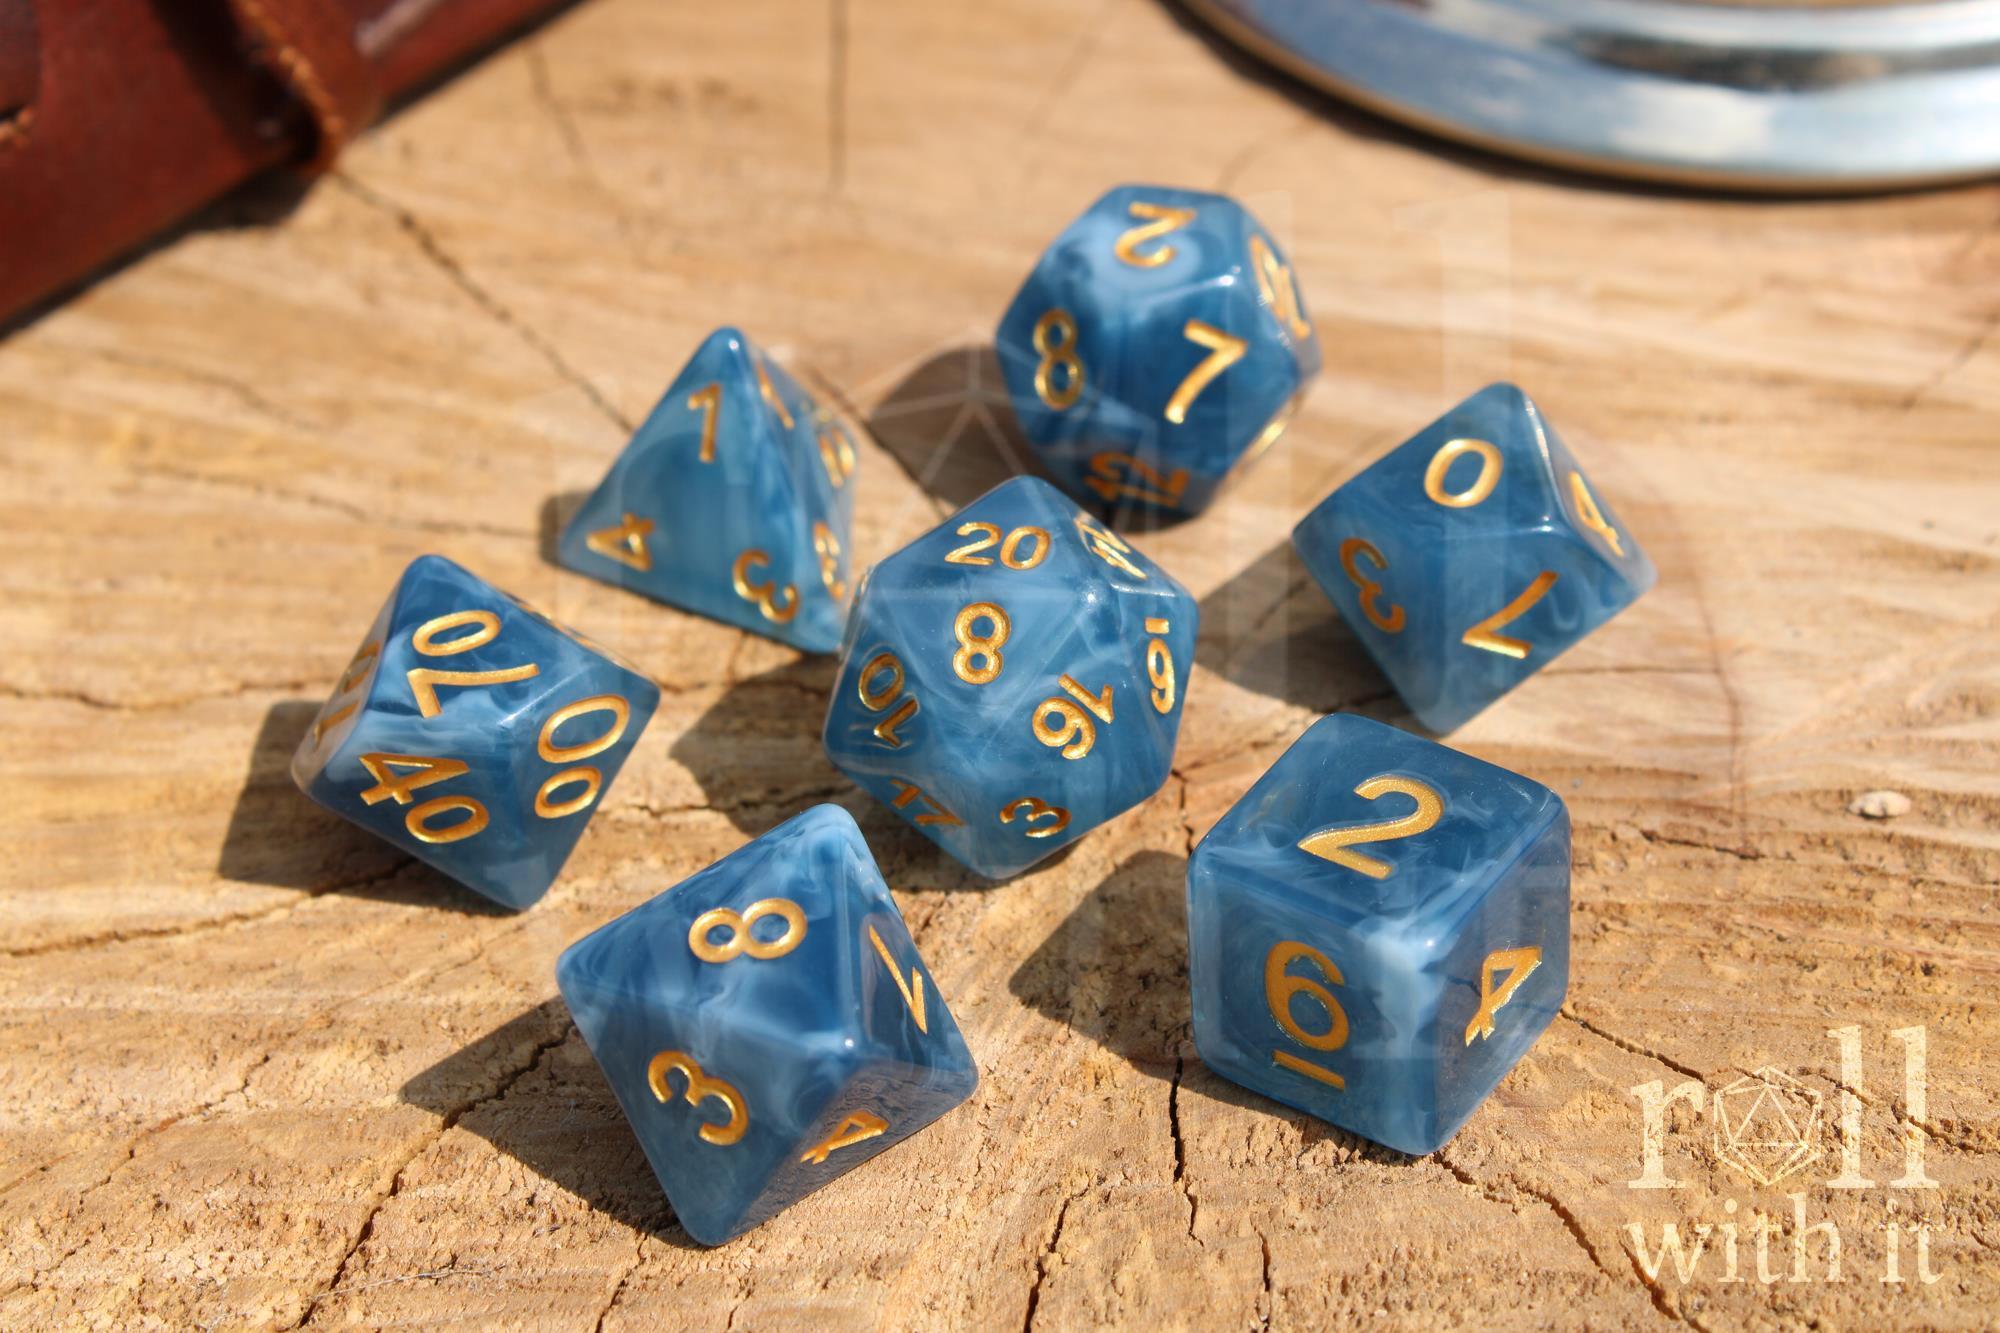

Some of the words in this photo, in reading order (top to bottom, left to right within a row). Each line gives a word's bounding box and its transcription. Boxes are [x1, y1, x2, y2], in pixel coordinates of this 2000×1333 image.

[1115, 201, 1196, 268] 2
[1033, 307, 1084, 411] 8
[1165, 319, 1247, 424] 7
[687, 382, 722, 464] 1
[1424, 438, 1503, 508] 0
[1569, 471, 1624, 557] 4
[586, 512, 655, 572] 4
[732, 547, 797, 623] 3
[944, 522, 1051, 570] 20
[1339, 537, 1406, 634] 3
[953, 602, 1011, 684] 8
[1461, 570, 1559, 659] 7
[407, 610, 540, 720] 70
[858, 652, 918, 747] 10
[1032, 673, 1113, 760] 16
[359, 752, 490, 843] 40
[1000, 798, 1071, 838] 3
[1297, 773, 1445, 880] 2
[688, 897, 808, 964] 8
[1264, 939, 1351, 1093] 6
[1464, 946, 1543, 1047] 4
[647, 1050, 750, 1147] 3
[800, 1109, 890, 1165] 4
